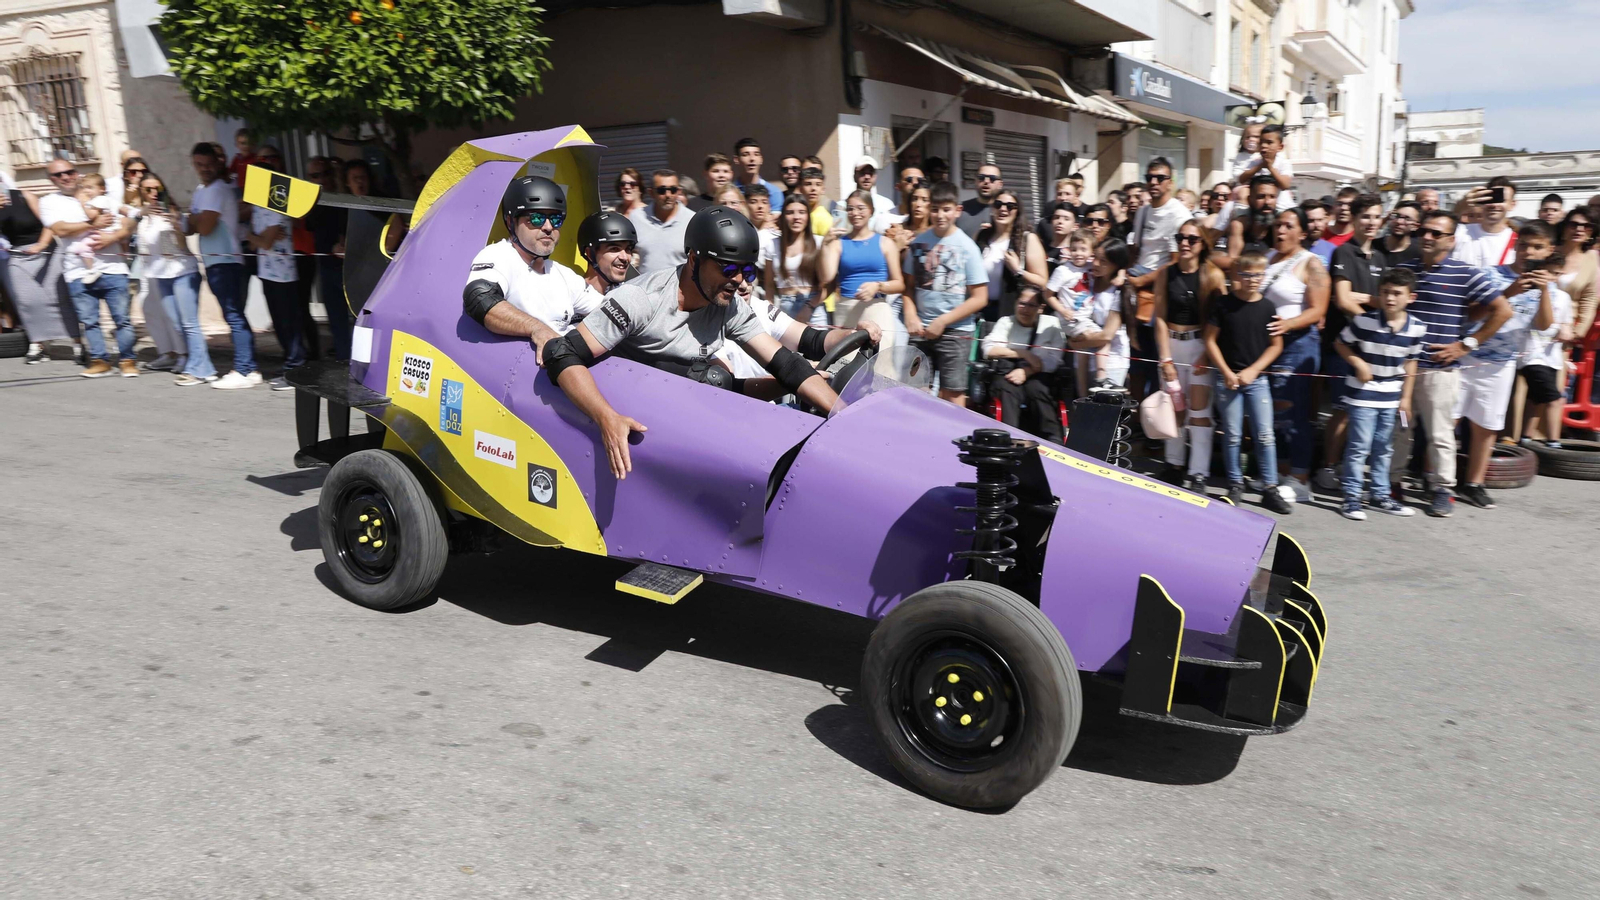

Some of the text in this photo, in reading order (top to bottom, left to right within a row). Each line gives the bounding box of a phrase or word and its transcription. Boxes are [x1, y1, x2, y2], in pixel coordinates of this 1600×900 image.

[405, 356, 431, 370] KIOSCO
[403, 366, 430, 381] CASUSO
[449, 408, 458, 421] la
[446, 420, 462, 432] paz
[476, 441, 515, 461] FotoLab
